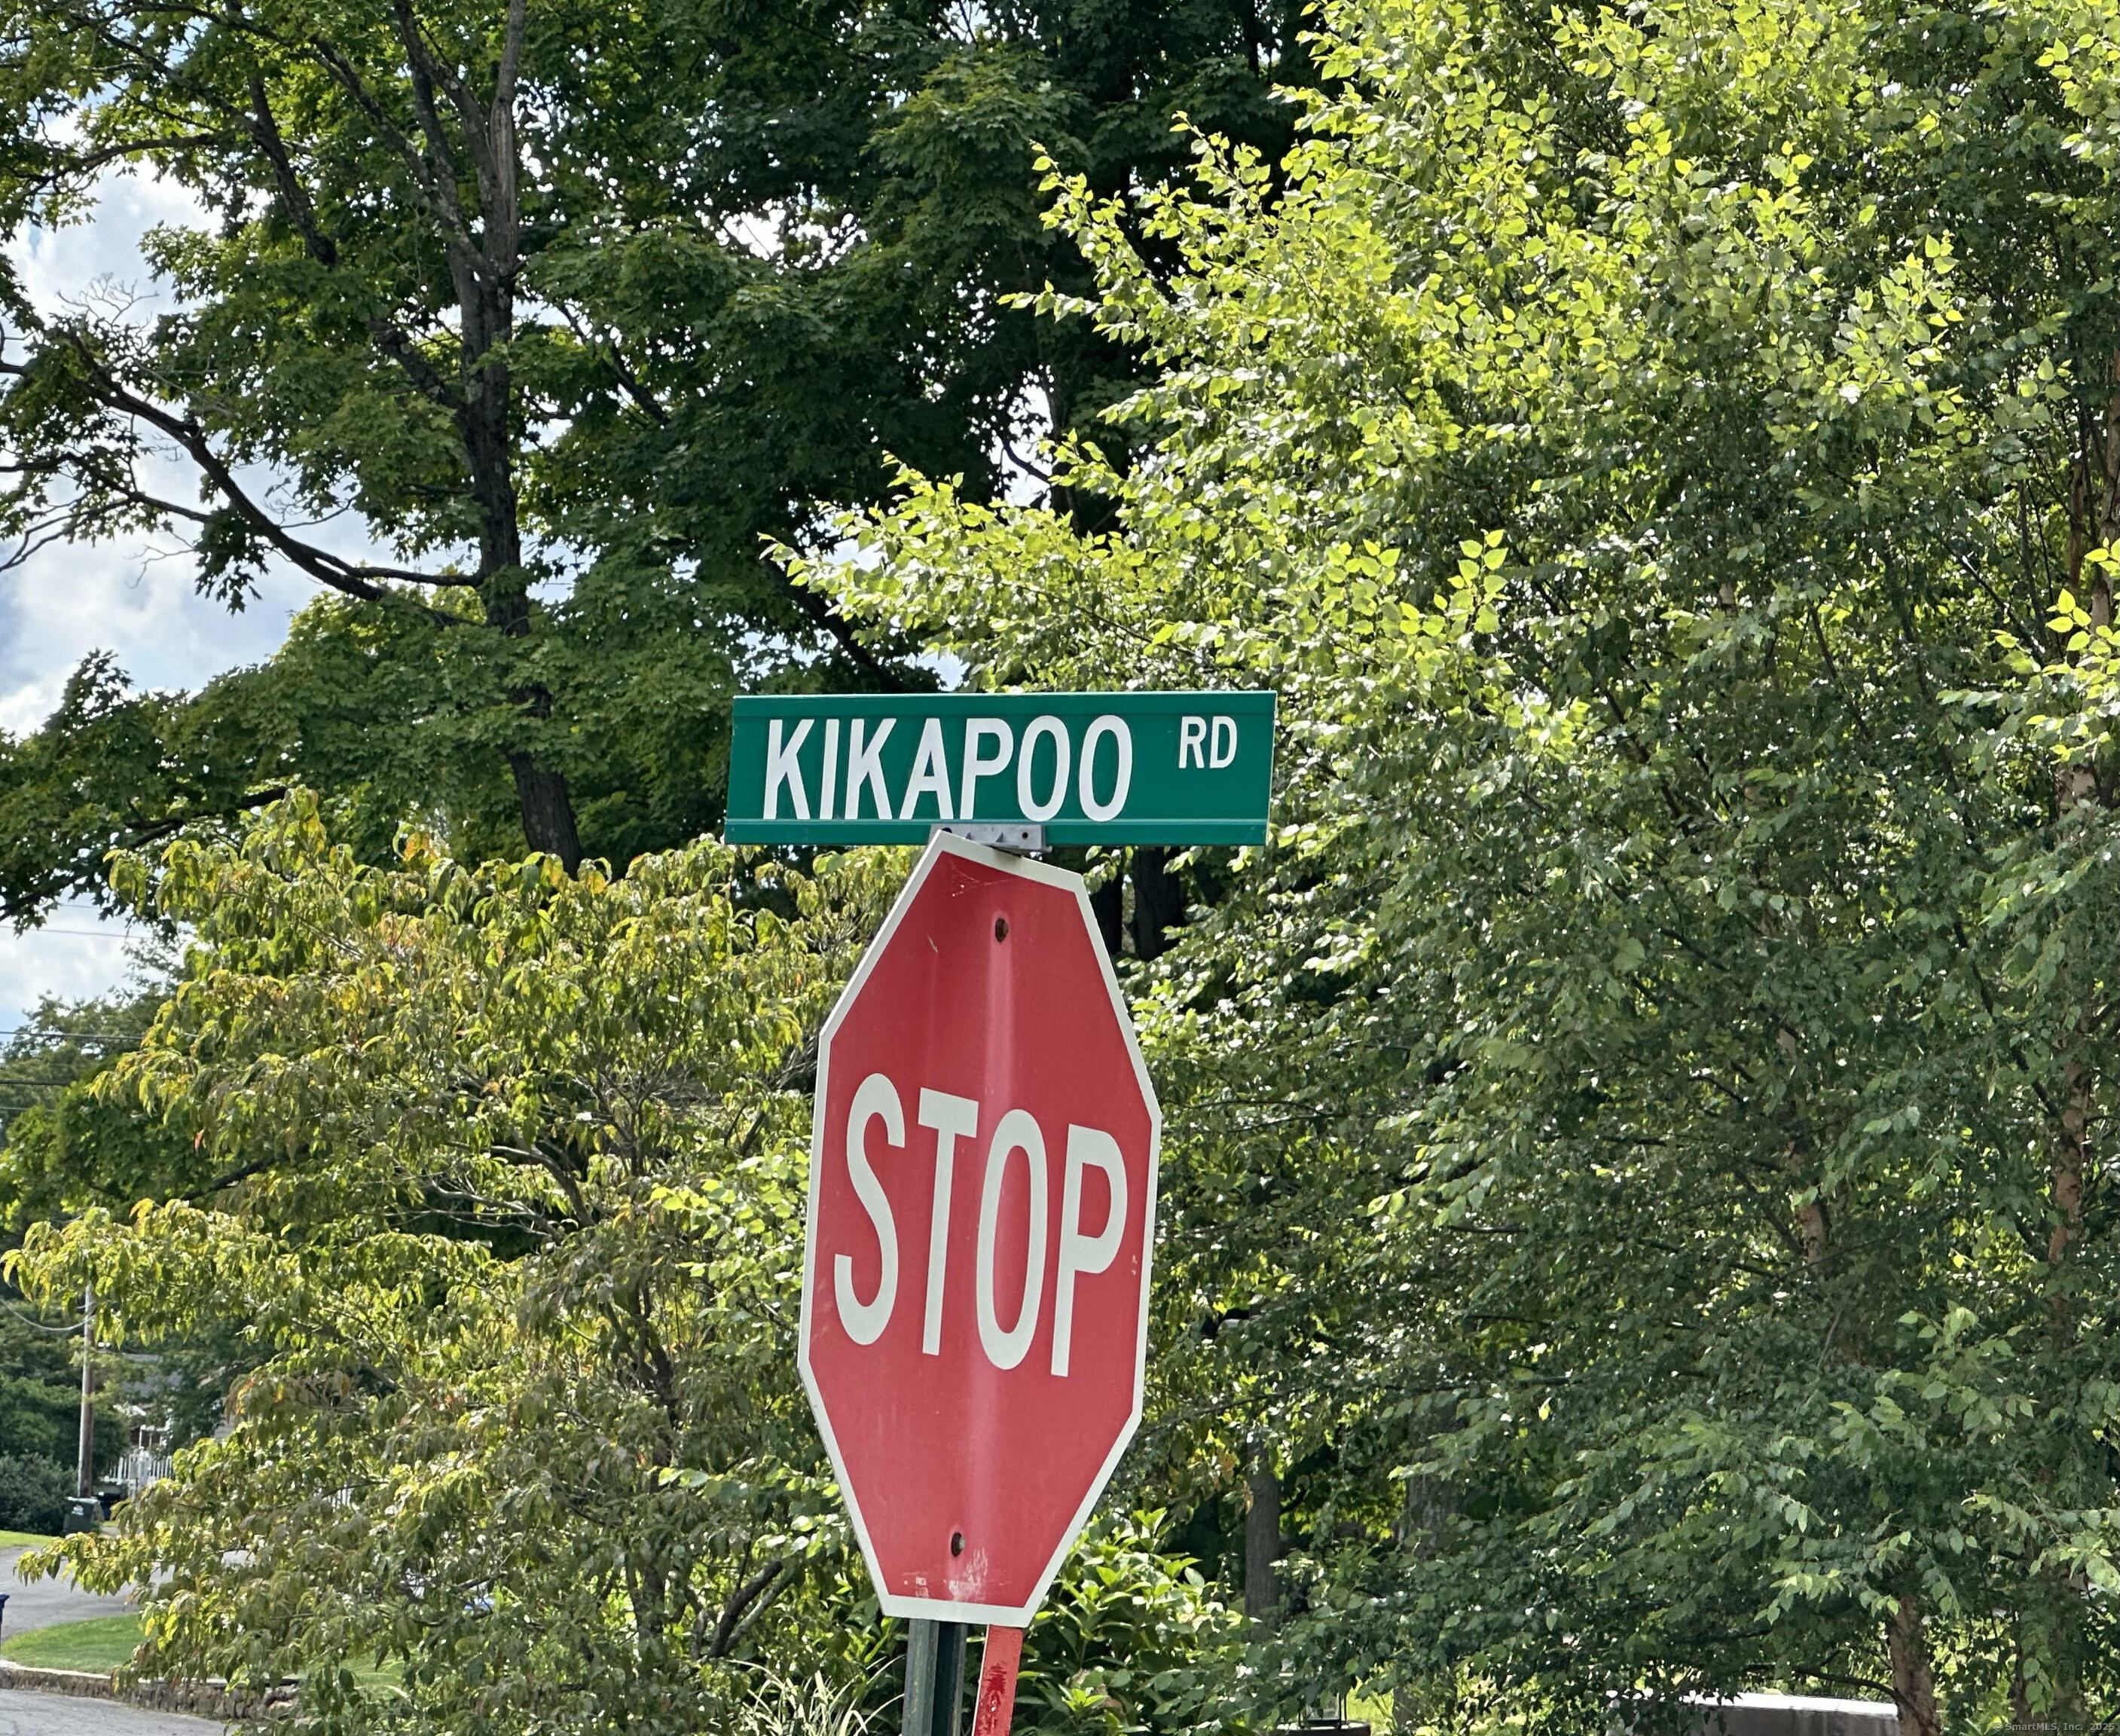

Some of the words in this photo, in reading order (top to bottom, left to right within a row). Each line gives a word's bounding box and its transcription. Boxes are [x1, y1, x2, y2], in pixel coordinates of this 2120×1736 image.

[762, 714, 1133, 822] KIKAPOO
[1178, 716, 1238, 769] RD
[834, 1073, 1128, 1377] STOP
